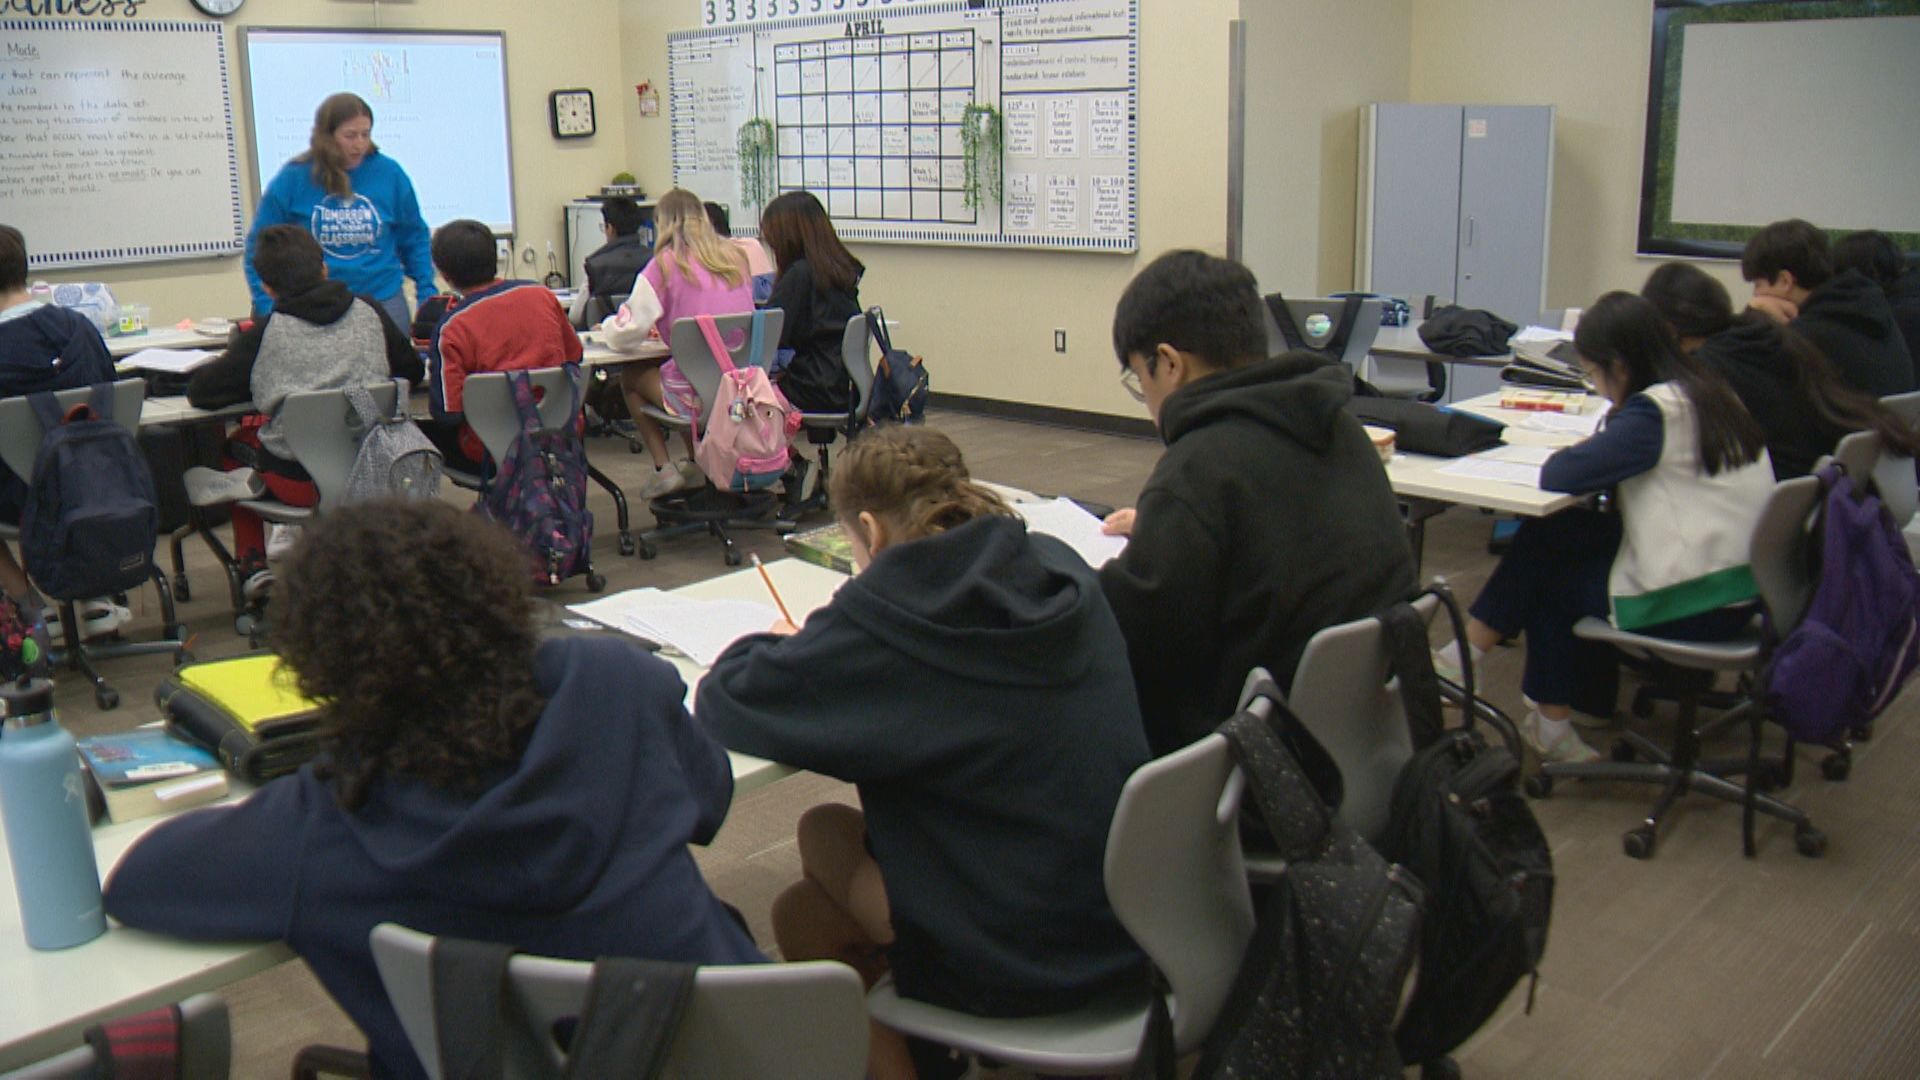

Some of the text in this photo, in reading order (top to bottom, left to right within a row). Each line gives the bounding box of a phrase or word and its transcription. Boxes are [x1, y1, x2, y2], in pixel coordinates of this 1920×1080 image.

[844, 18, 885, 36] APRIL
[12, 67, 187, 86] that can represent the average
[8, 85, 38, 96] data
[80, 99, 98, 111] the
[103, 99, 128, 110] data
[25, 131, 48, 142] that
[320, 206, 372, 222] TOMORROW
[320, 233, 376, 246] CLASSROOM
